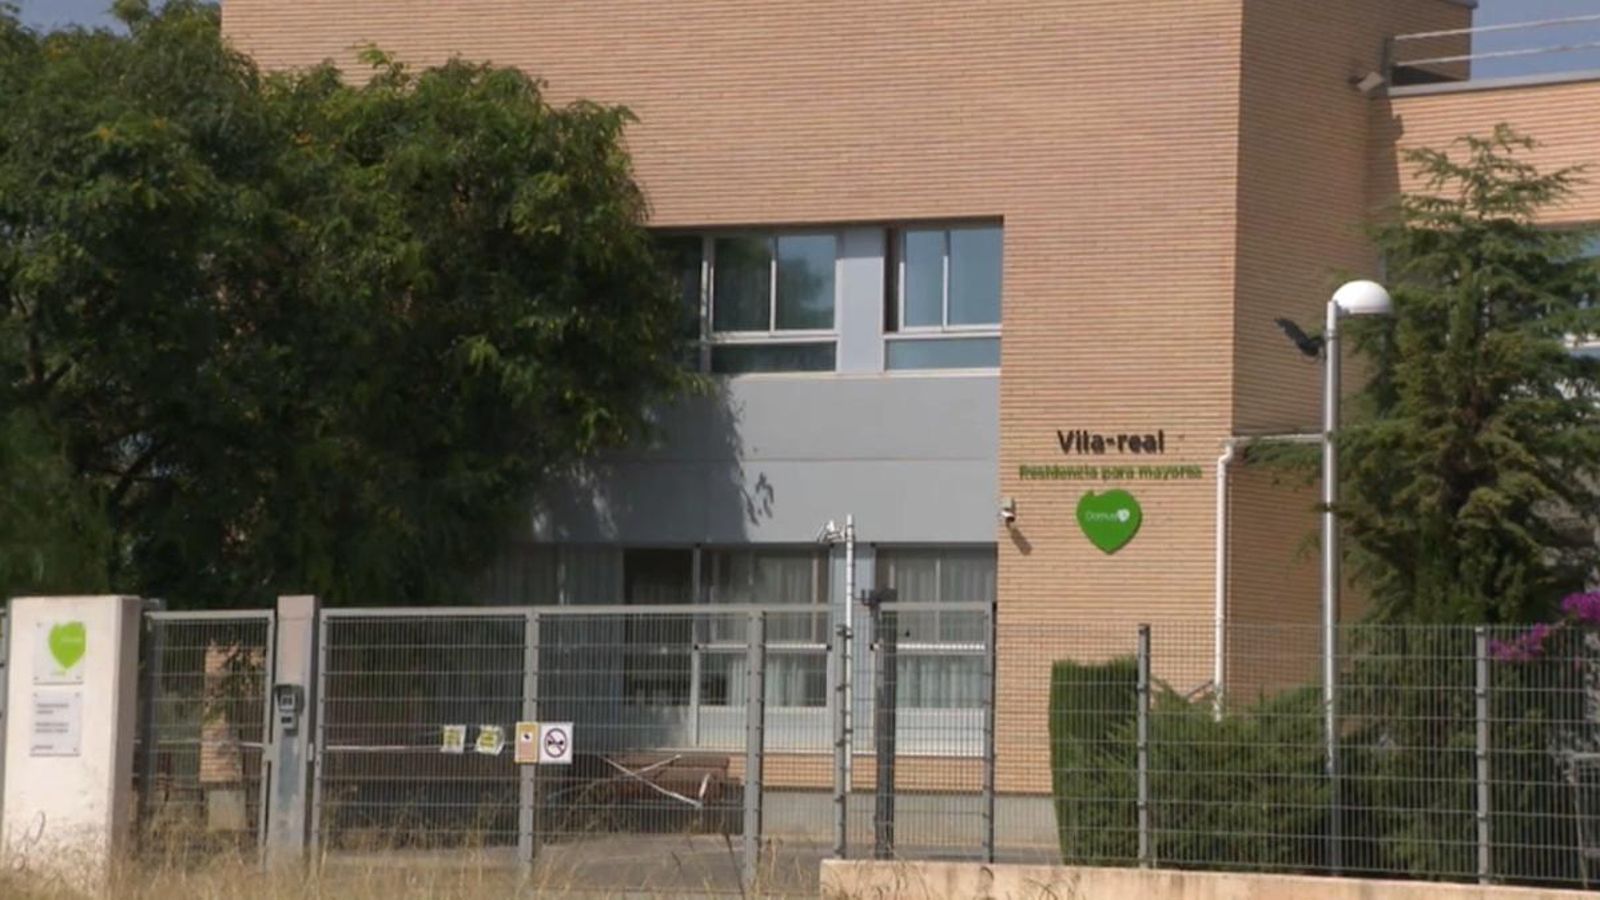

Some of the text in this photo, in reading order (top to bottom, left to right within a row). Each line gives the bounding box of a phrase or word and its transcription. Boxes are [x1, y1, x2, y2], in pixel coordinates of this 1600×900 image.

[1057, 429, 1165, 455] Vila-real
[1020, 465, 1097, 480] Residencia
[1102, 466, 1134, 482] para
